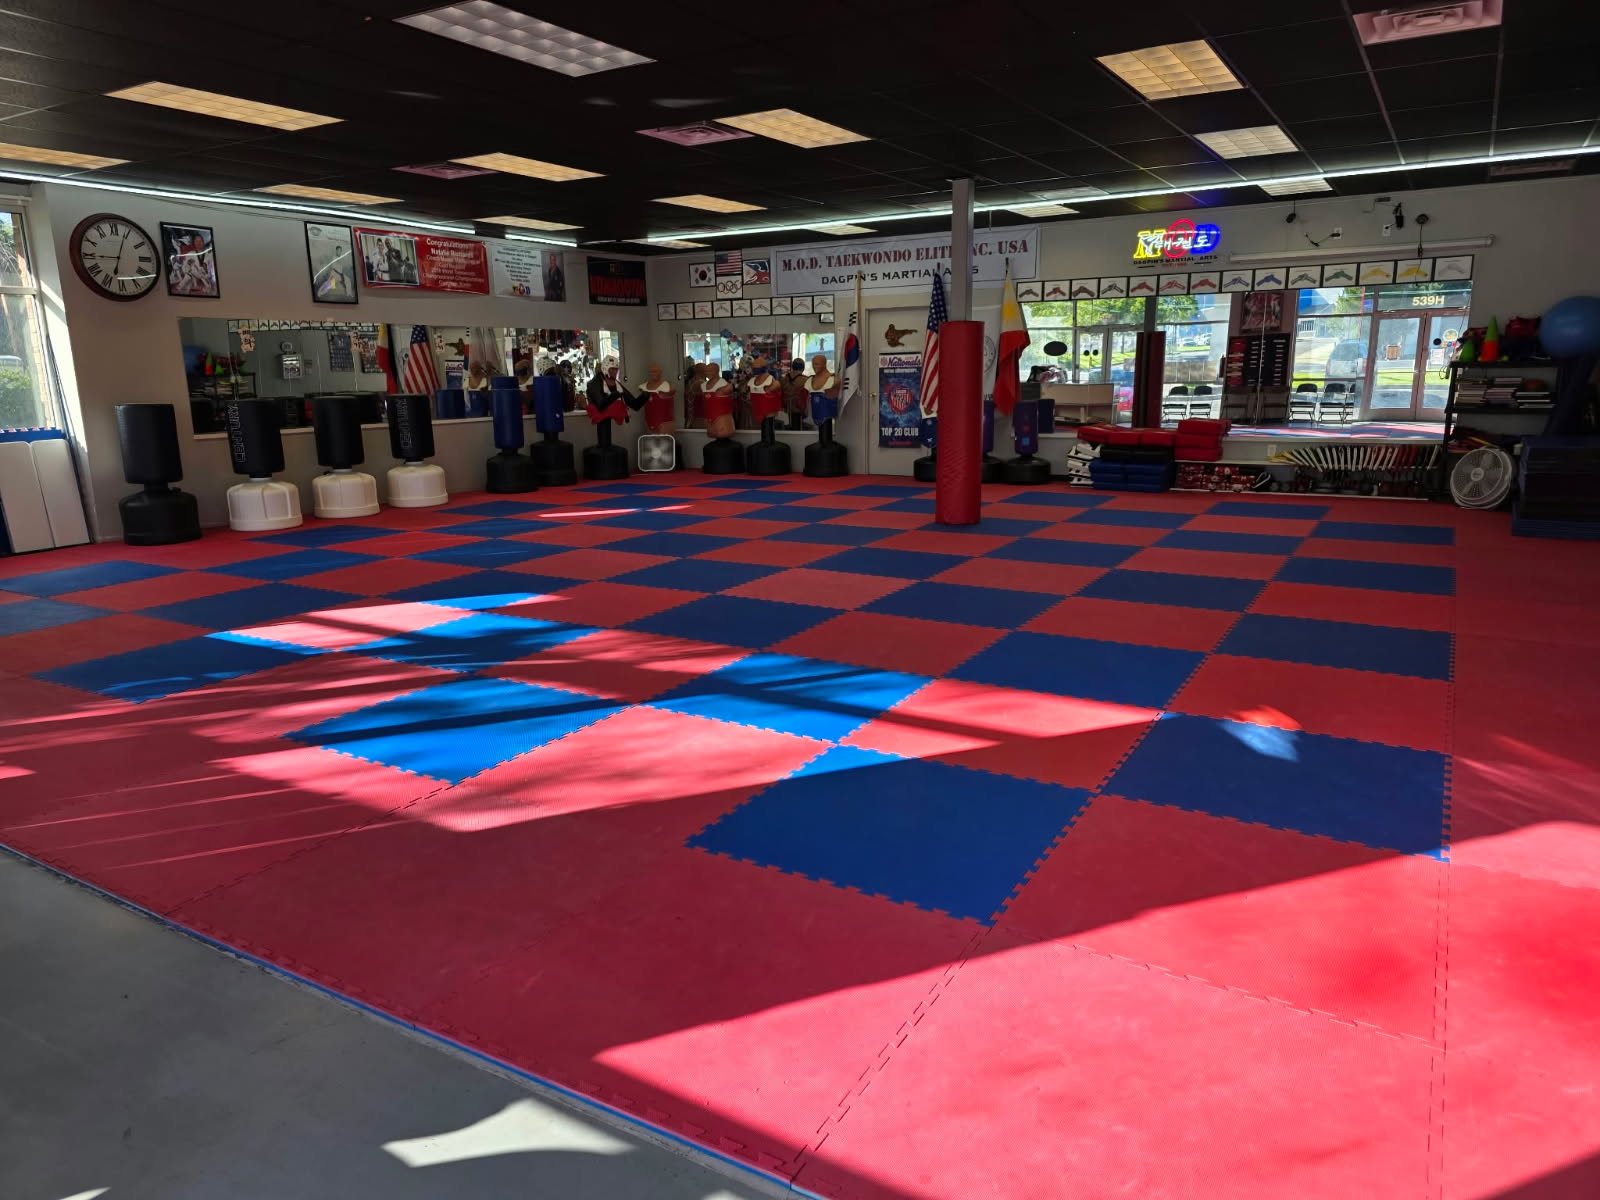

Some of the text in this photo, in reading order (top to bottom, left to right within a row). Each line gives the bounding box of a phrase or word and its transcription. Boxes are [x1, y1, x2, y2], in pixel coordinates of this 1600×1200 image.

[782, 257, 822, 272] M.O.D.
[826, 248, 912, 268] TAEKWONDO
[972, 242, 992, 256] NC.
[998, 240, 1028, 254] USA
[1412, 296, 1445, 306] 539H
[881, 428, 919, 437] TOP 20 CLUB
